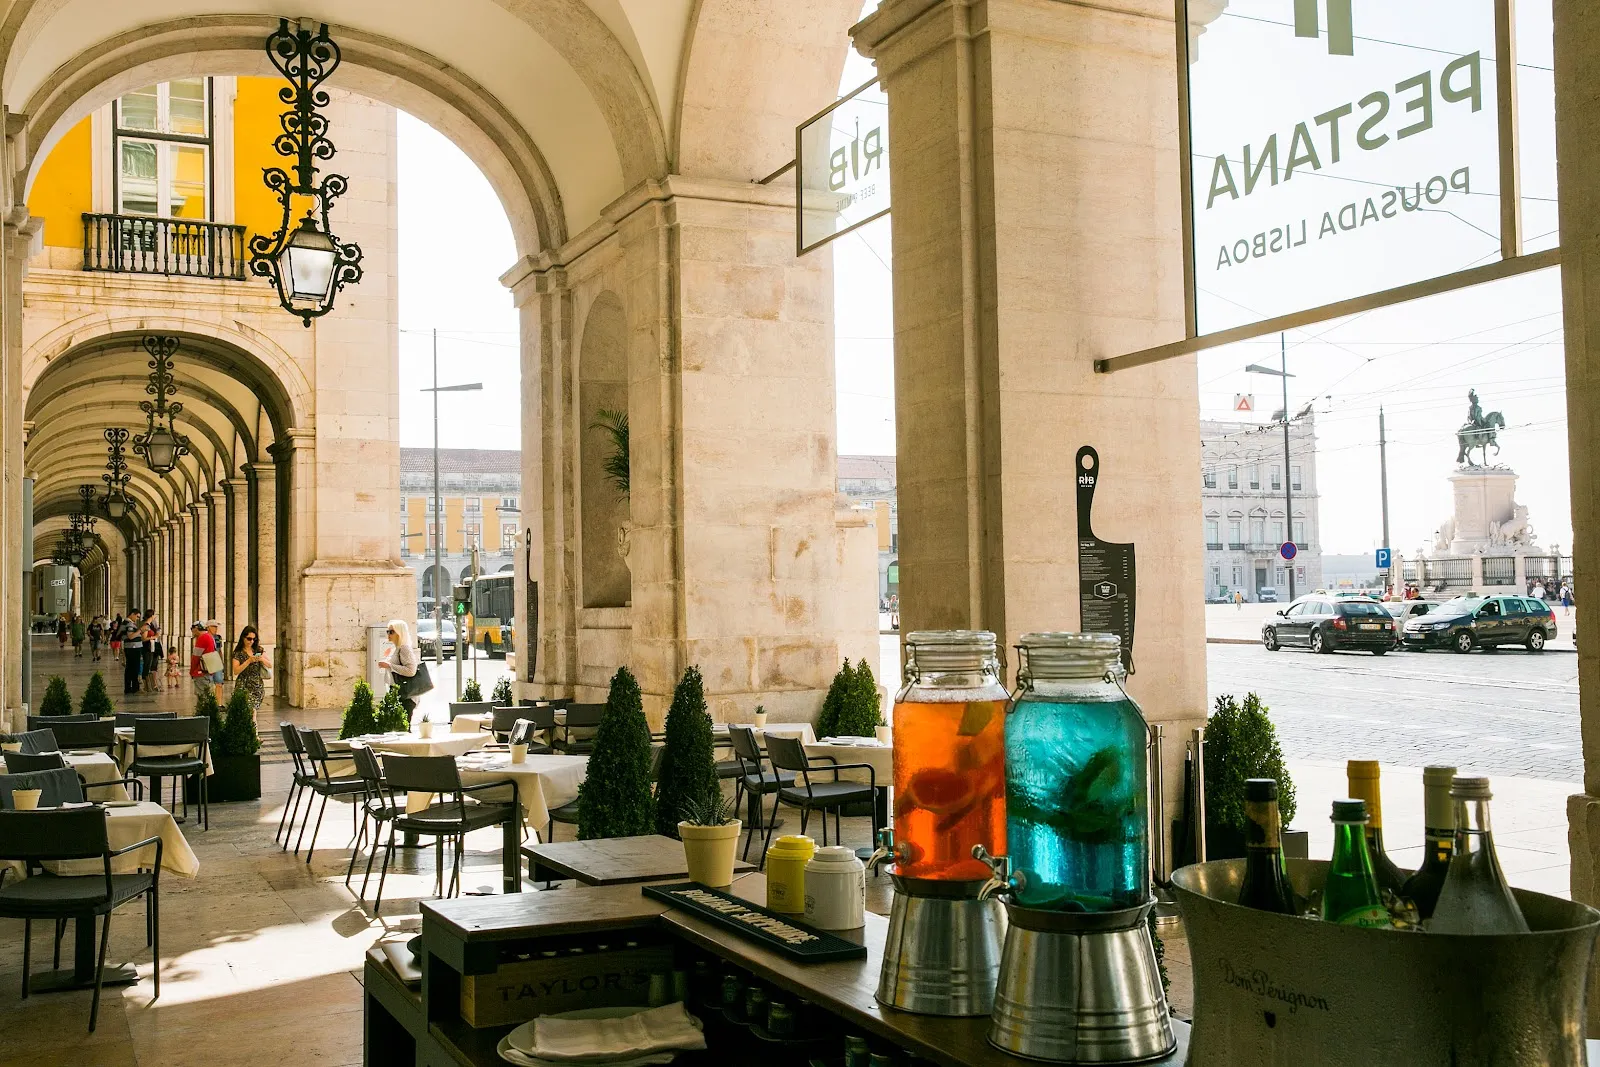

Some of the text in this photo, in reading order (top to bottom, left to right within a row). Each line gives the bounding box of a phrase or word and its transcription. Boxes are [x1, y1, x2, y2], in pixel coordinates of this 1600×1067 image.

[1378, 550, 1388, 566] P
[1219, 957, 1331, 1014] Dom Pérignon
